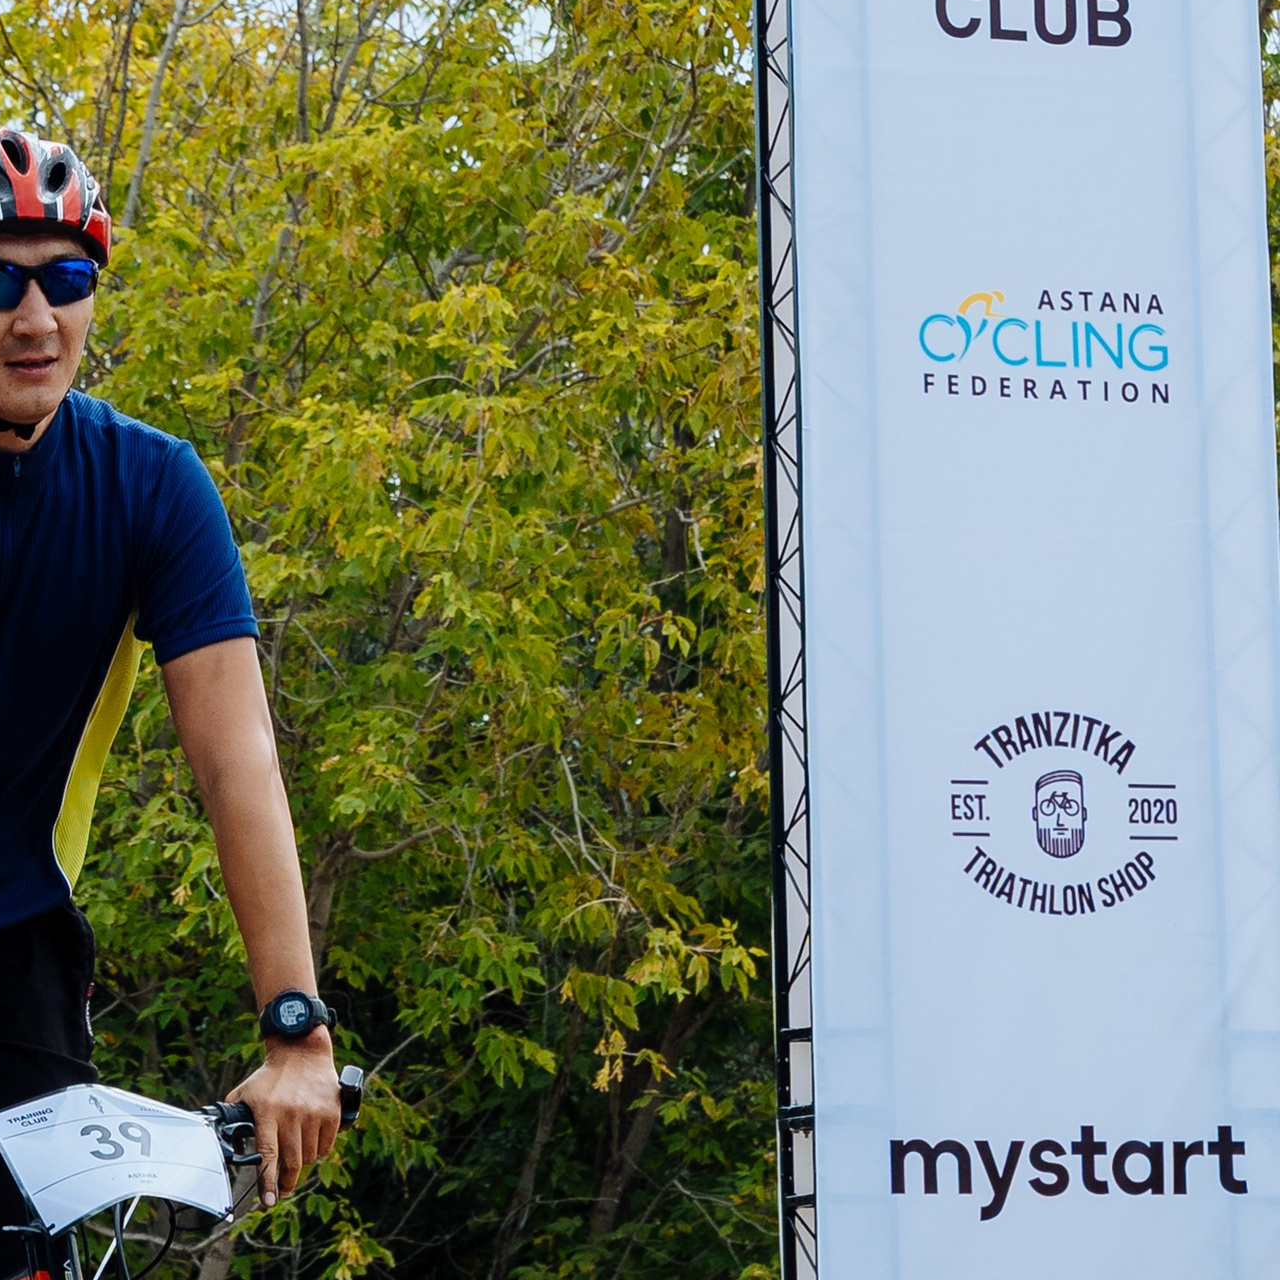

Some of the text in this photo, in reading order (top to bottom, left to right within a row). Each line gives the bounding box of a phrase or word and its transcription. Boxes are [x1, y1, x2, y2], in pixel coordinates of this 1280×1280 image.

[1037, 289, 1164, 315] ASTANA
[918, 313, 1169, 372] CYCLING
[923, 373, 1170, 404] FEDERATION
[973, 711, 1136, 776] TRANZITKA
[951, 794, 991, 821] EST.
[1128, 798, 1178, 825] 2020
[963, 845, 1156, 916] TRIATHLON SHOP
[7, 1107, 54, 1124] TRAINING
[20, 1116, 48, 1127] CLUB
[80, 1121, 152, 1161] 39
[889, 1125, 1249, 1222] mystart
